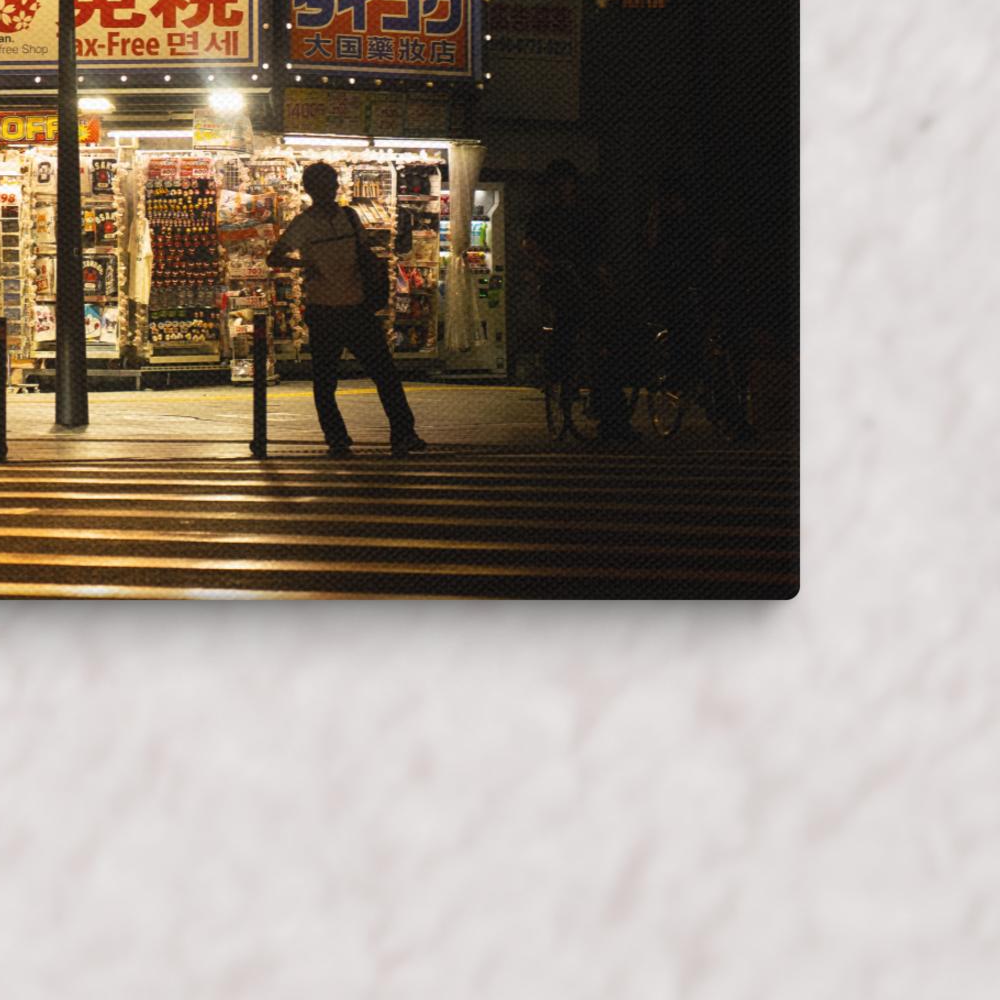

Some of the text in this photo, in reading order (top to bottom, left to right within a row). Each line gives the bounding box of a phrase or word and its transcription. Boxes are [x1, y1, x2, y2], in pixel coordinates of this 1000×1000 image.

[21, 44, 49, 56] Shop
[57, 31, 160, 58] ax-Free
[166, 31, 240, 57] 면세
